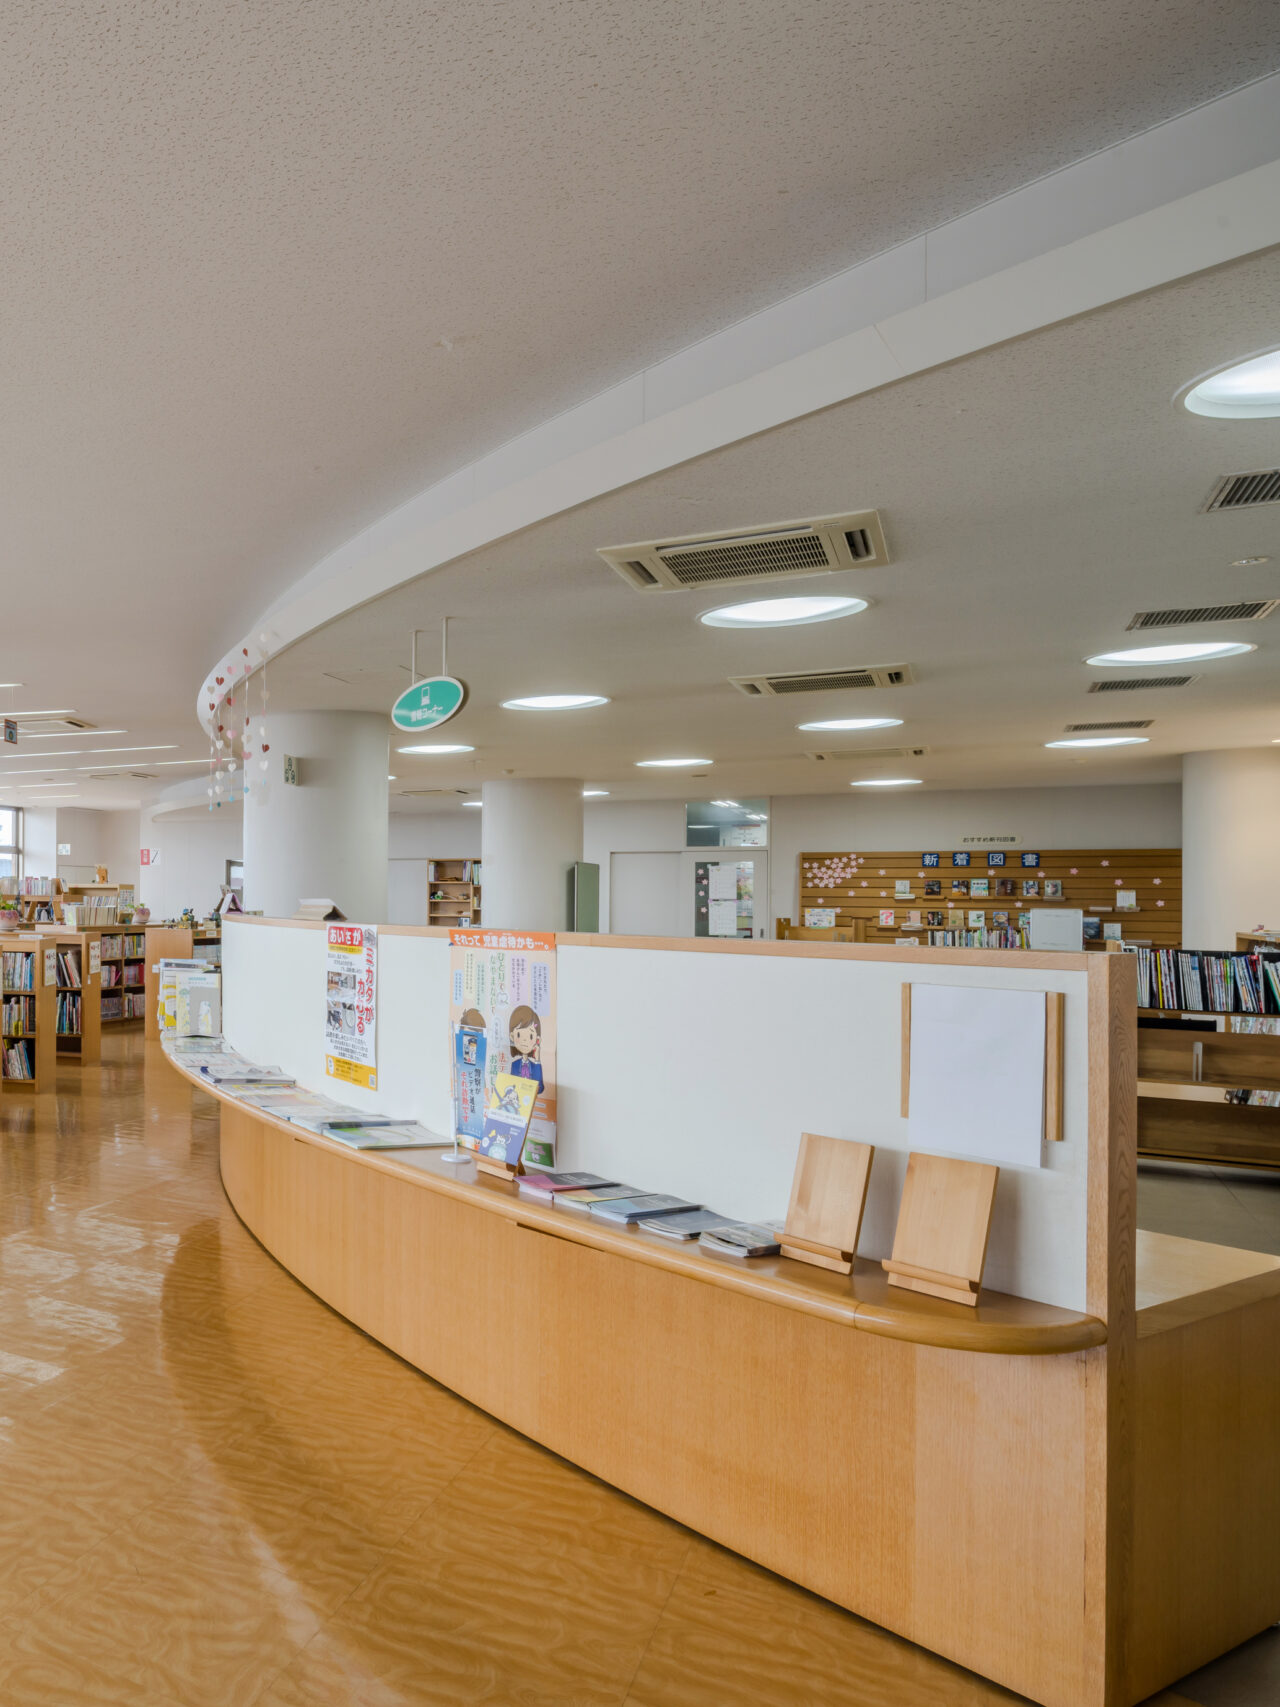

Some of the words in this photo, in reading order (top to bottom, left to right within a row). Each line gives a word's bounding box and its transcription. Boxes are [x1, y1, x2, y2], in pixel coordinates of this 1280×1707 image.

[328, 929, 363, 946] あいさが
[453, 933, 481, 946] それって
